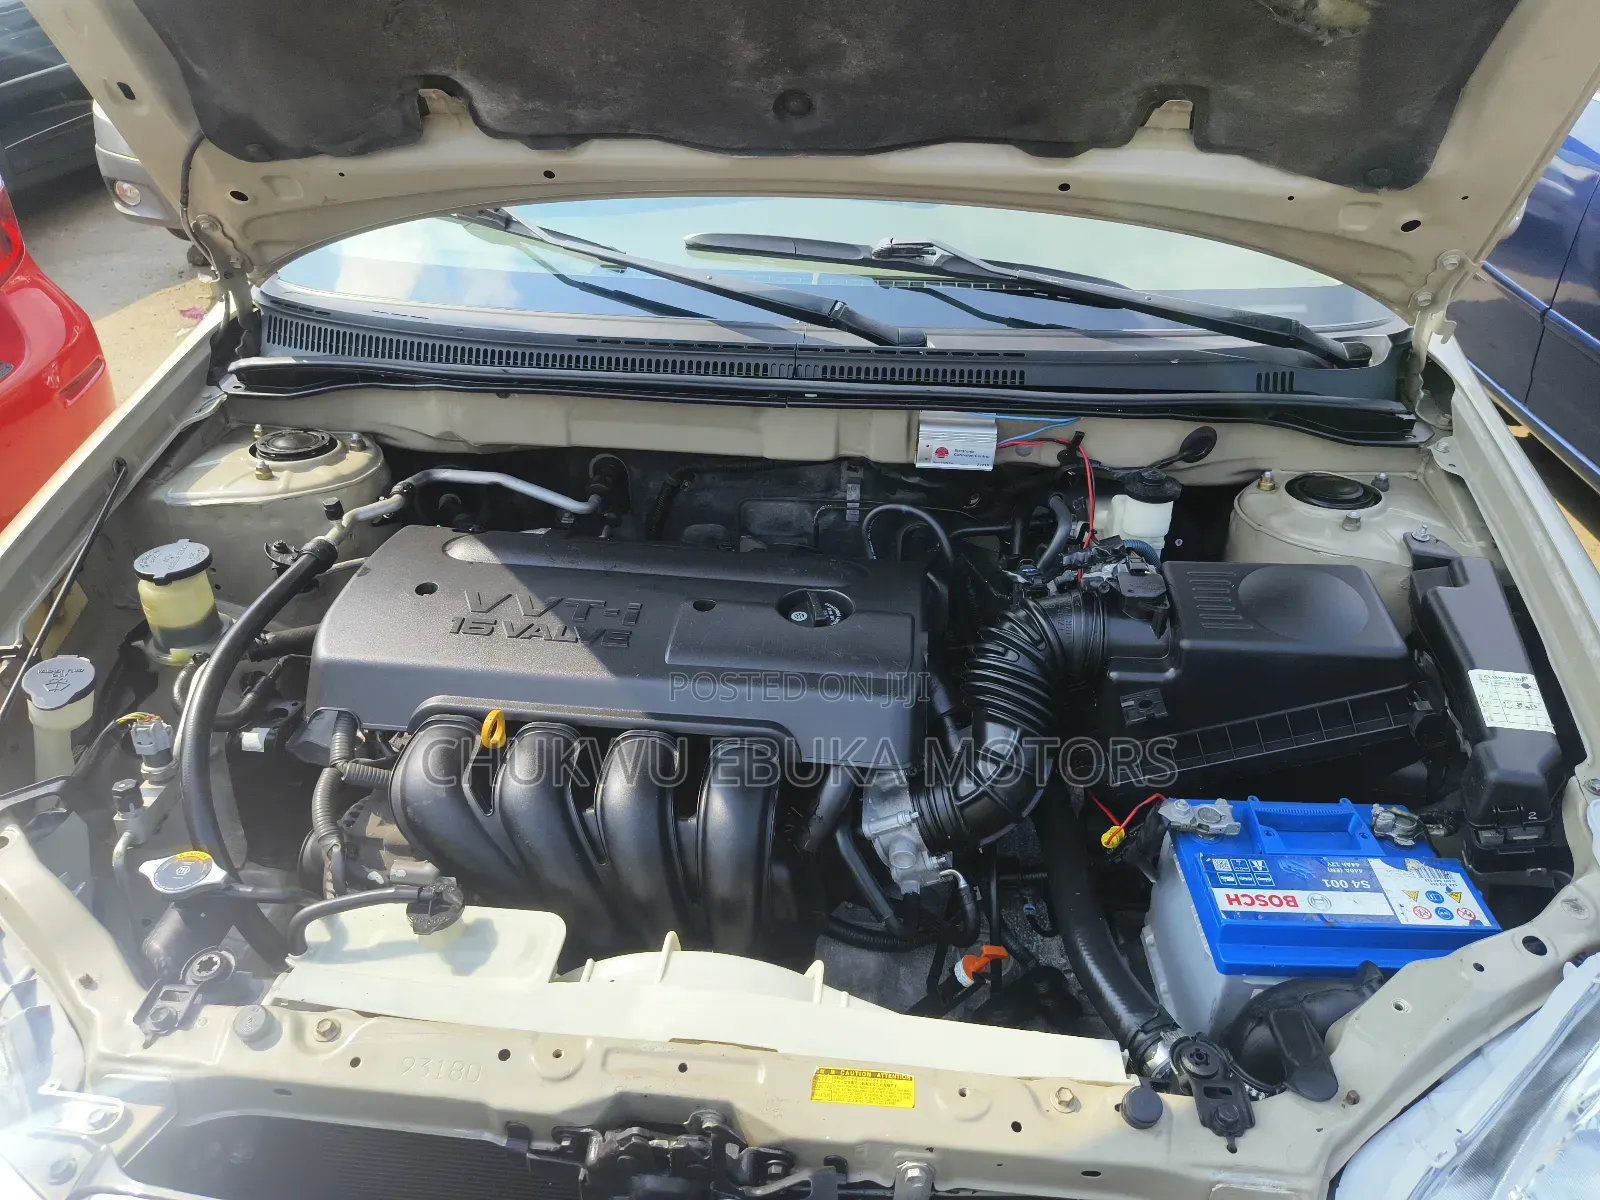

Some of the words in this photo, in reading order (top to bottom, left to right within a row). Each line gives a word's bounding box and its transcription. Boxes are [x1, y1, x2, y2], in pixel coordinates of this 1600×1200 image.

[450, 616, 498, 637] 16
[502, 620, 633, 648] VALVE
[1528, 811, 1538, 820] 2
[1321, 878, 1349, 889] 001
[1351, 879, 1371, 889] S4
[1225, 893, 1299, 908] BOSCH
[400, 1055, 483, 1083] 93180
[875, 1073, 912, 1081] ATTENTION
